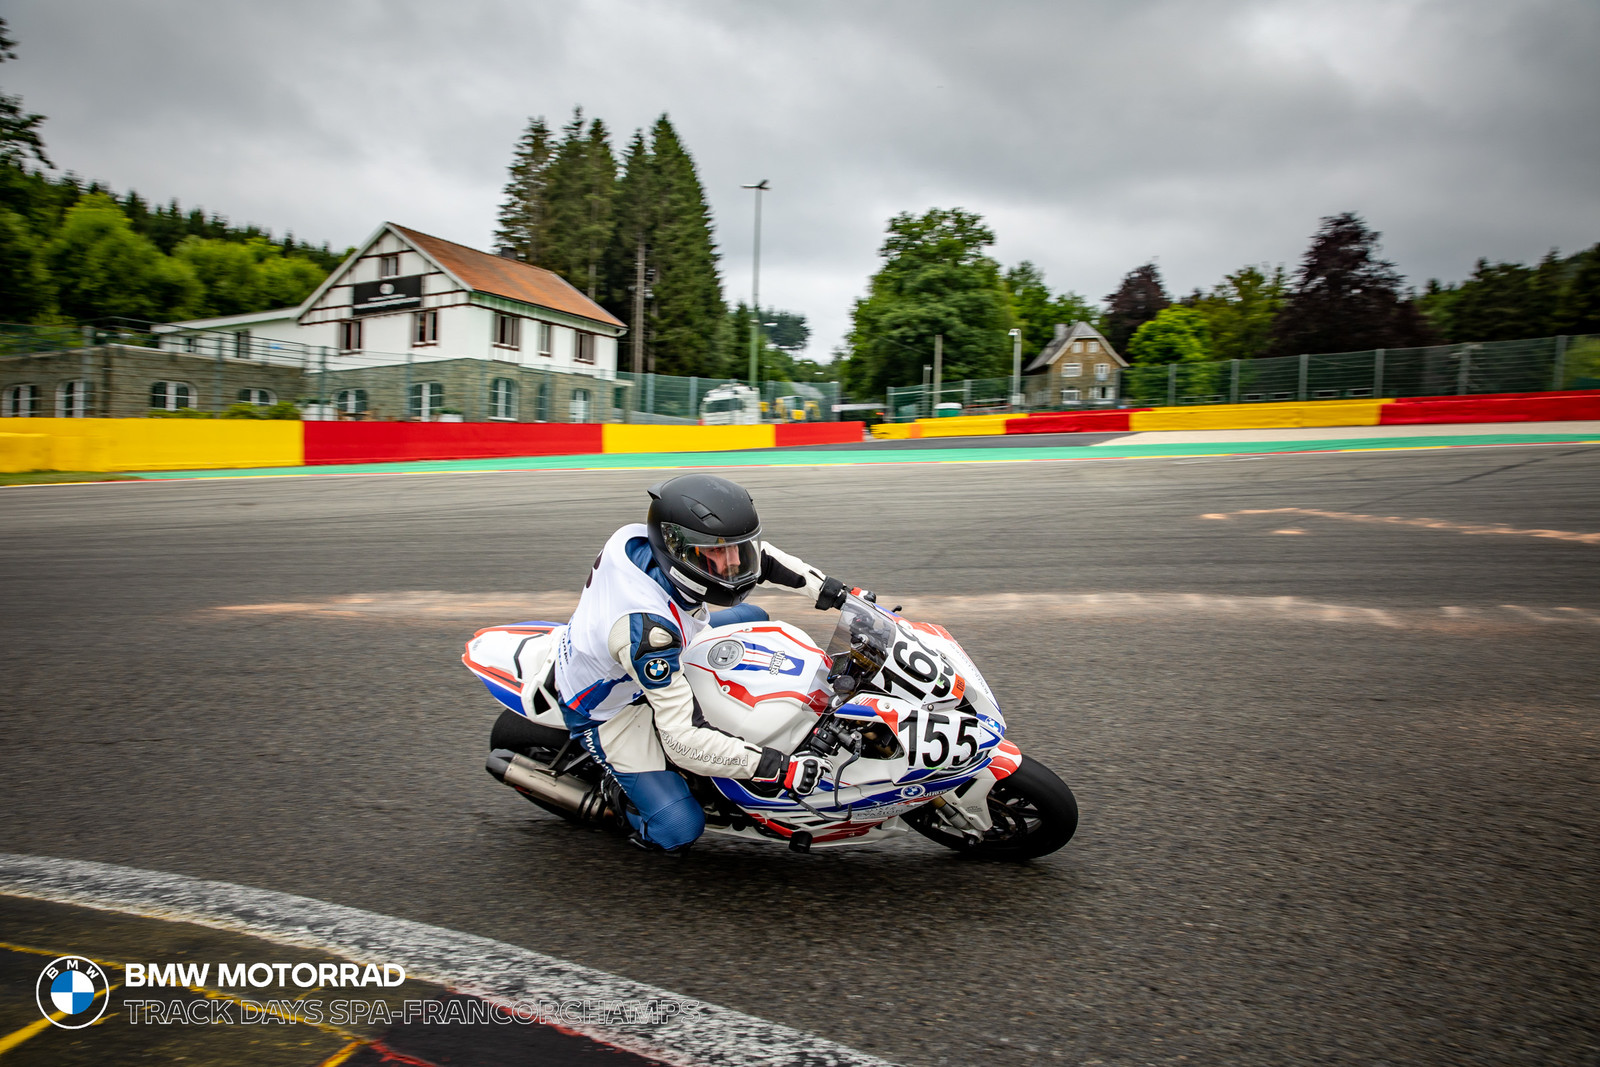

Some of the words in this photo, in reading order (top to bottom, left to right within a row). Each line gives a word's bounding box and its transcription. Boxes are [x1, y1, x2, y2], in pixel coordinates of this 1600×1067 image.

[660, 729, 691, 756] BMW
[689, 748, 749, 767] Motorrad
[898, 709, 979, 767] 155
